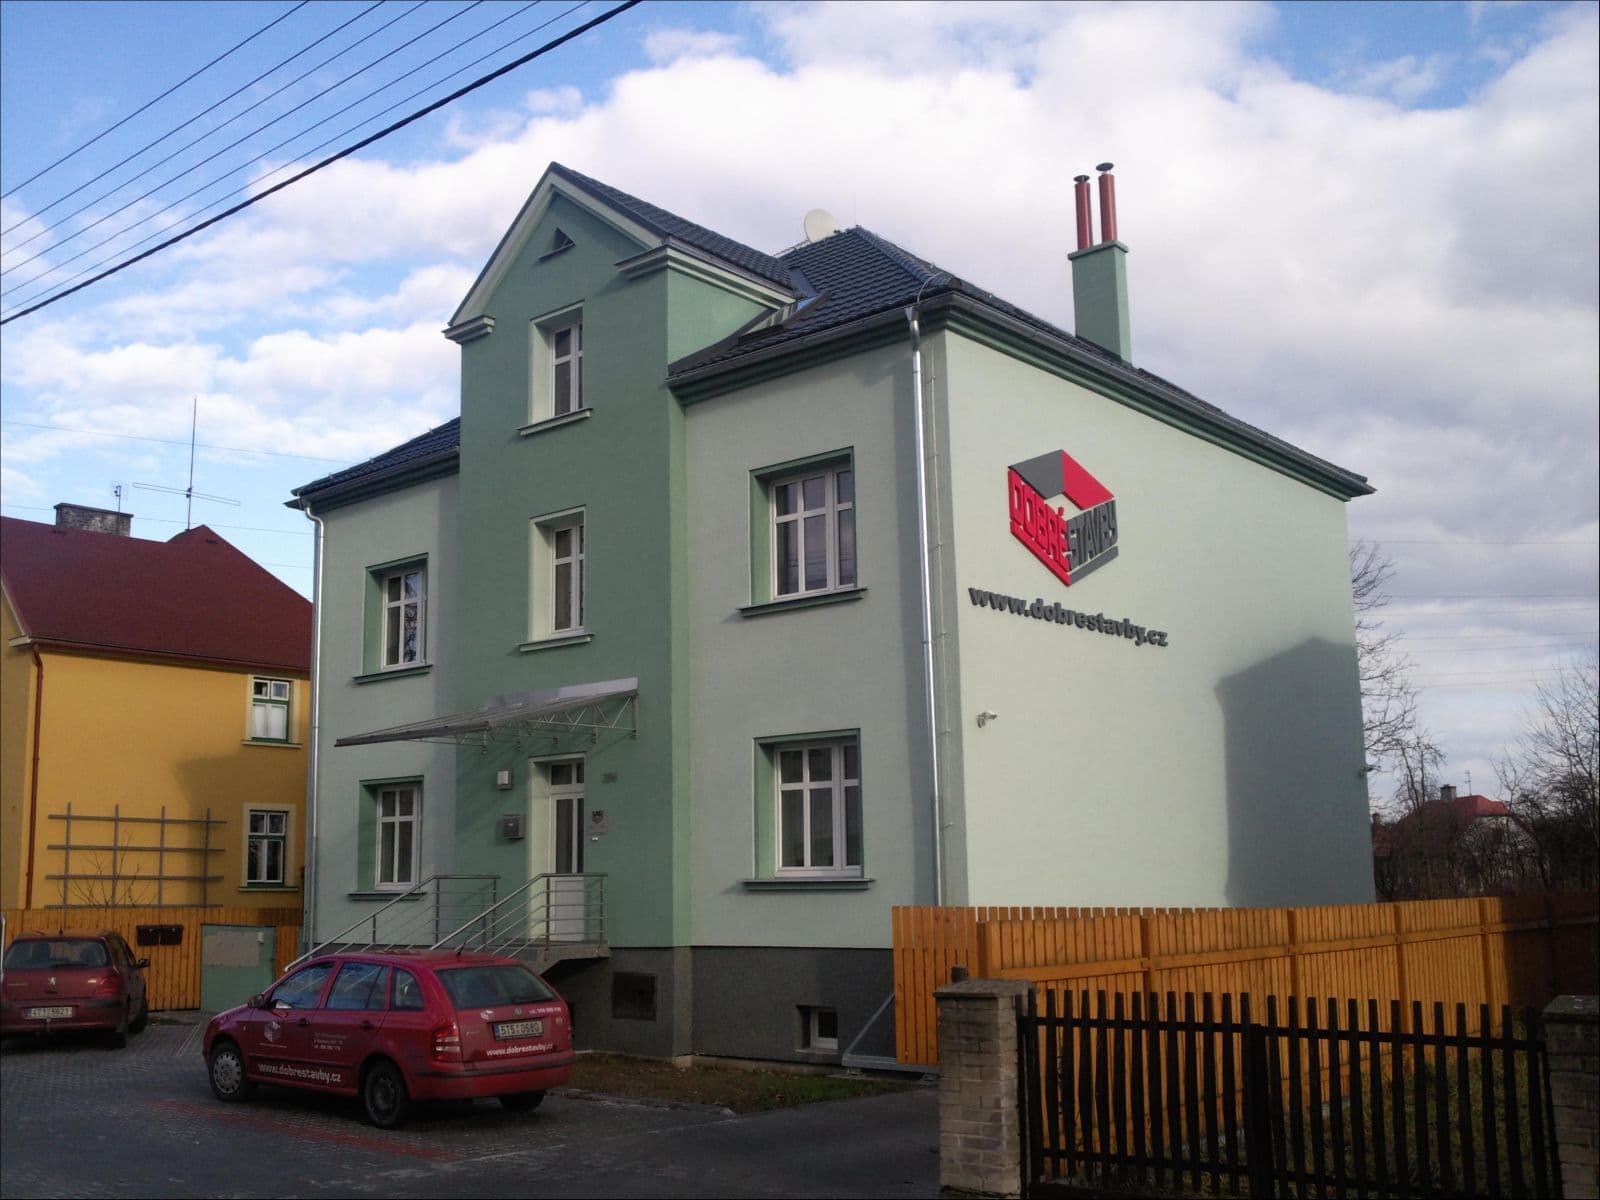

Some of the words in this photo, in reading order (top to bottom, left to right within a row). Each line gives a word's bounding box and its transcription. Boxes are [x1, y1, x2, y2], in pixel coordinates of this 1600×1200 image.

[1008, 469, 1070, 572] DOBRÉ
[1067, 500, 1118, 571] STAVBY
[968, 587, 1168, 646] www.dobrestavby.cz
[258, 1063, 341, 1083] www.dobrestavby.cz
